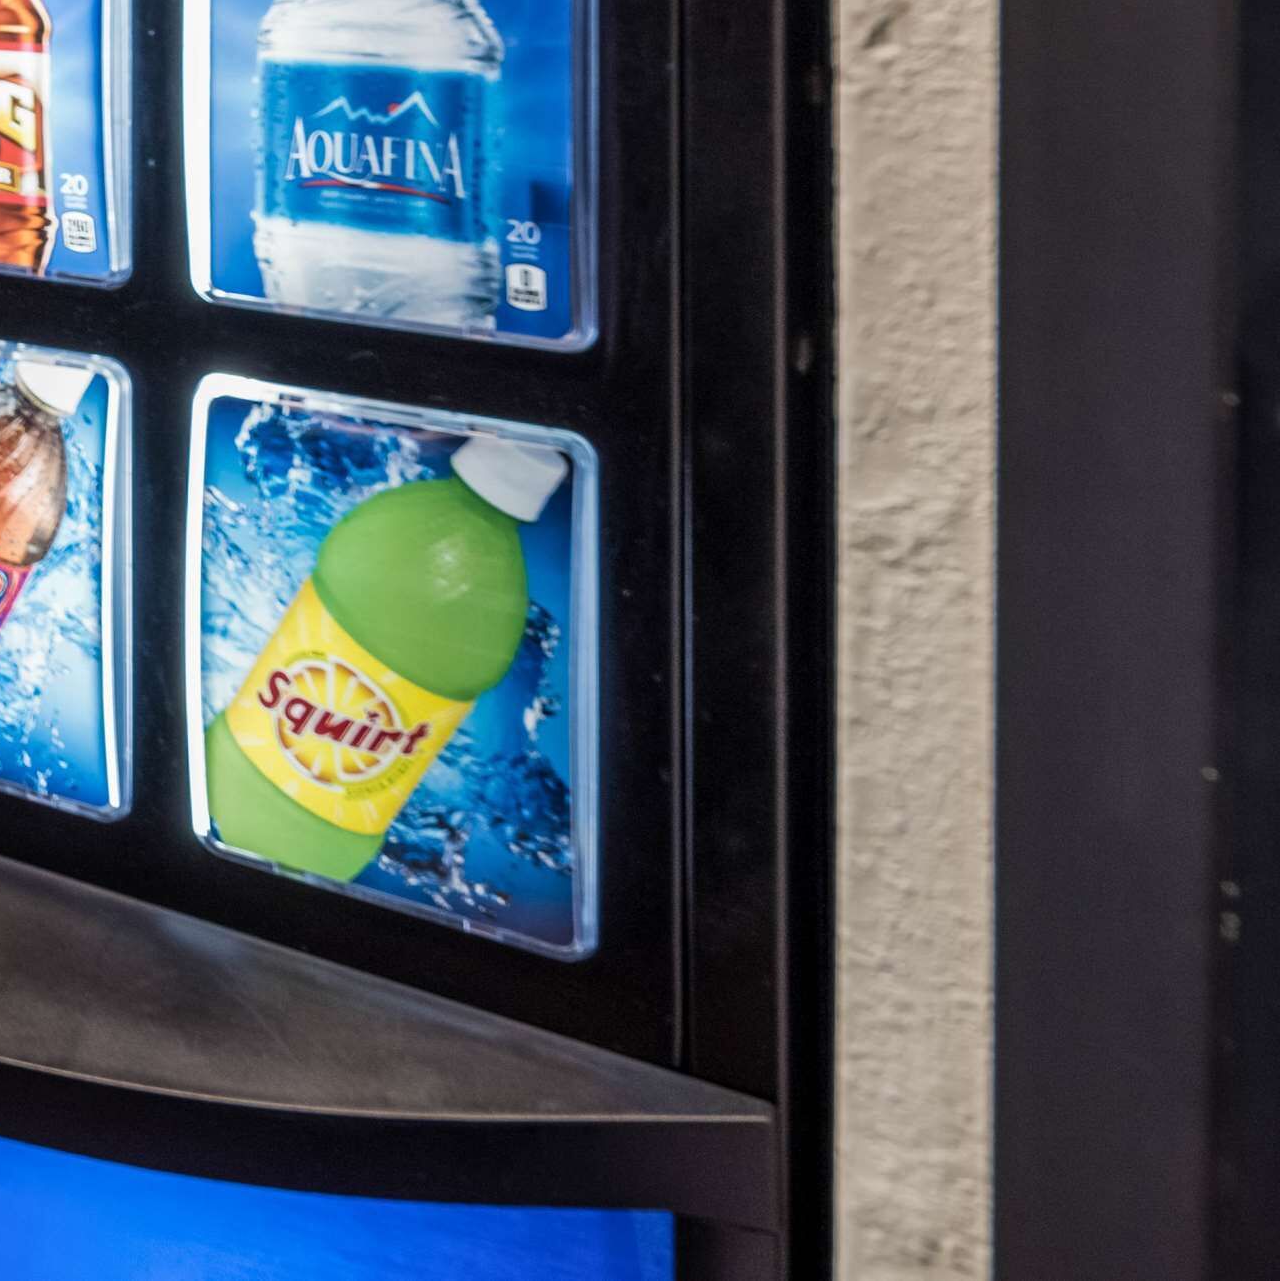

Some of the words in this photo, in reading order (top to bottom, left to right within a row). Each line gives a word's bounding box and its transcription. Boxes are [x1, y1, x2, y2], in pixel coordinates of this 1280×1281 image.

[59, 173, 88, 196] 20
[284, 115, 467, 199] AQUAFINA
[506, 219, 541, 245] 20
[258, 670, 429, 754] Squirt
